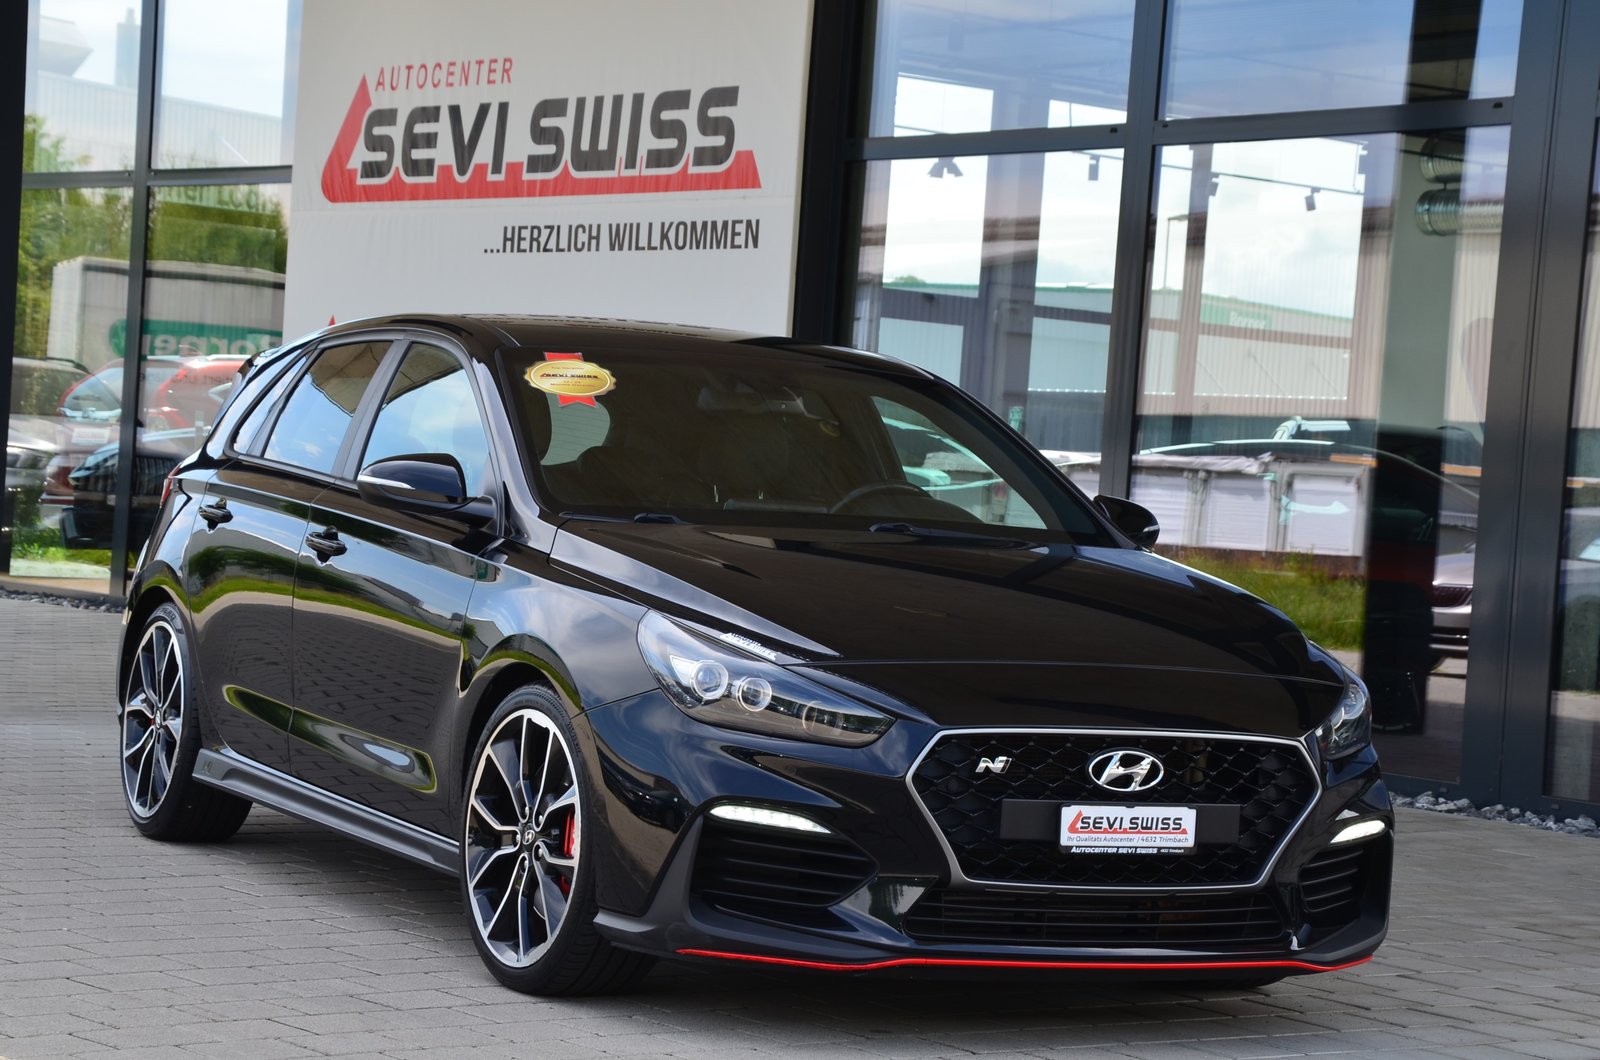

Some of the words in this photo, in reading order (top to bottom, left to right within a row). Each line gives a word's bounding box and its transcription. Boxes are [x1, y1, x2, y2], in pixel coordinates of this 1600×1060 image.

[375, 57, 513, 92] AUTOCENTER
[360, 101, 509, 179] SEVI
[526, 86, 740, 174] SWISS
[483, 223, 601, 254] ...HERZLICH
[608, 219, 760, 252] WILLKOMMEN
[1080, 816, 1124, 830] SEVI
[1128, 817, 1183, 831] SWISS
